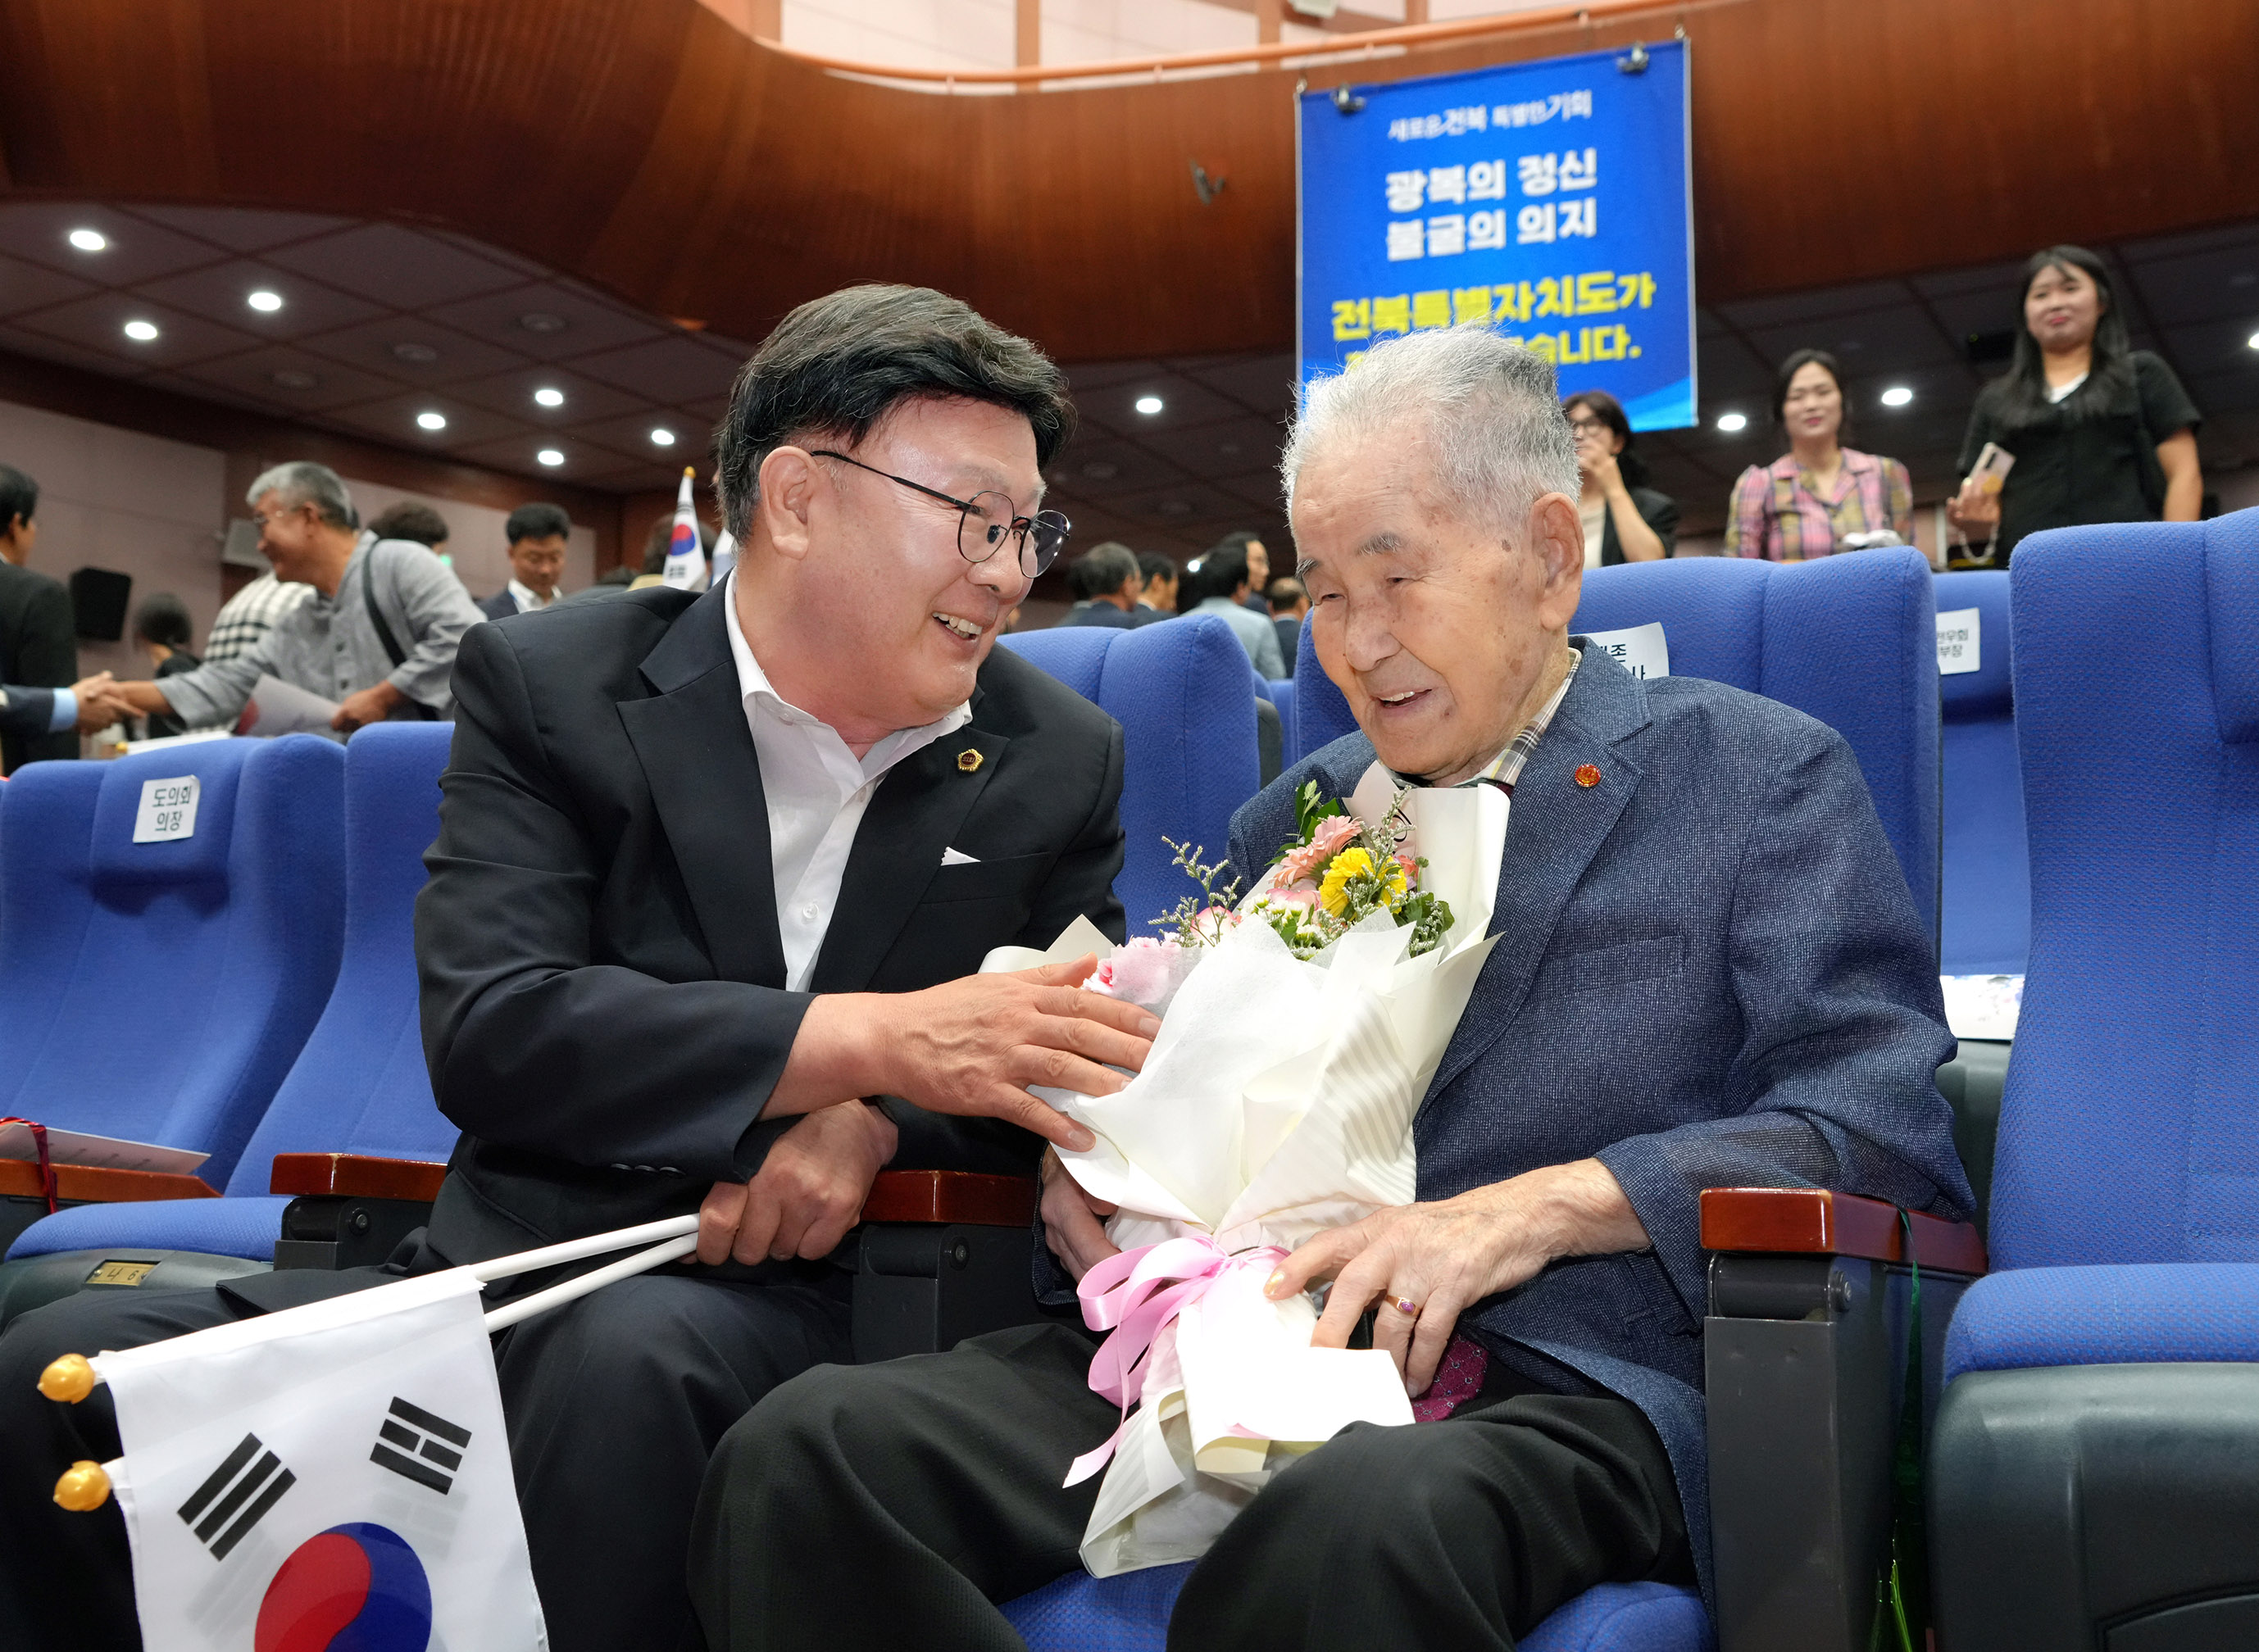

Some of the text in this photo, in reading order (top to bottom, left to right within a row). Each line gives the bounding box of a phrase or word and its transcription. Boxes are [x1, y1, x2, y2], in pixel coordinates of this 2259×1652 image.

[1547, 88, 1593, 121] 기회
[1385, 148, 1597, 212] 광복의 정신
[1385, 197, 1597, 261] 불굴의 의지
[1331, 270, 1657, 341] 전북특별자치도가
[1507, 324, 1642, 365] 습니다.
[152, 785, 193, 808] 도의회
[155, 810, 183, 832] 의장
